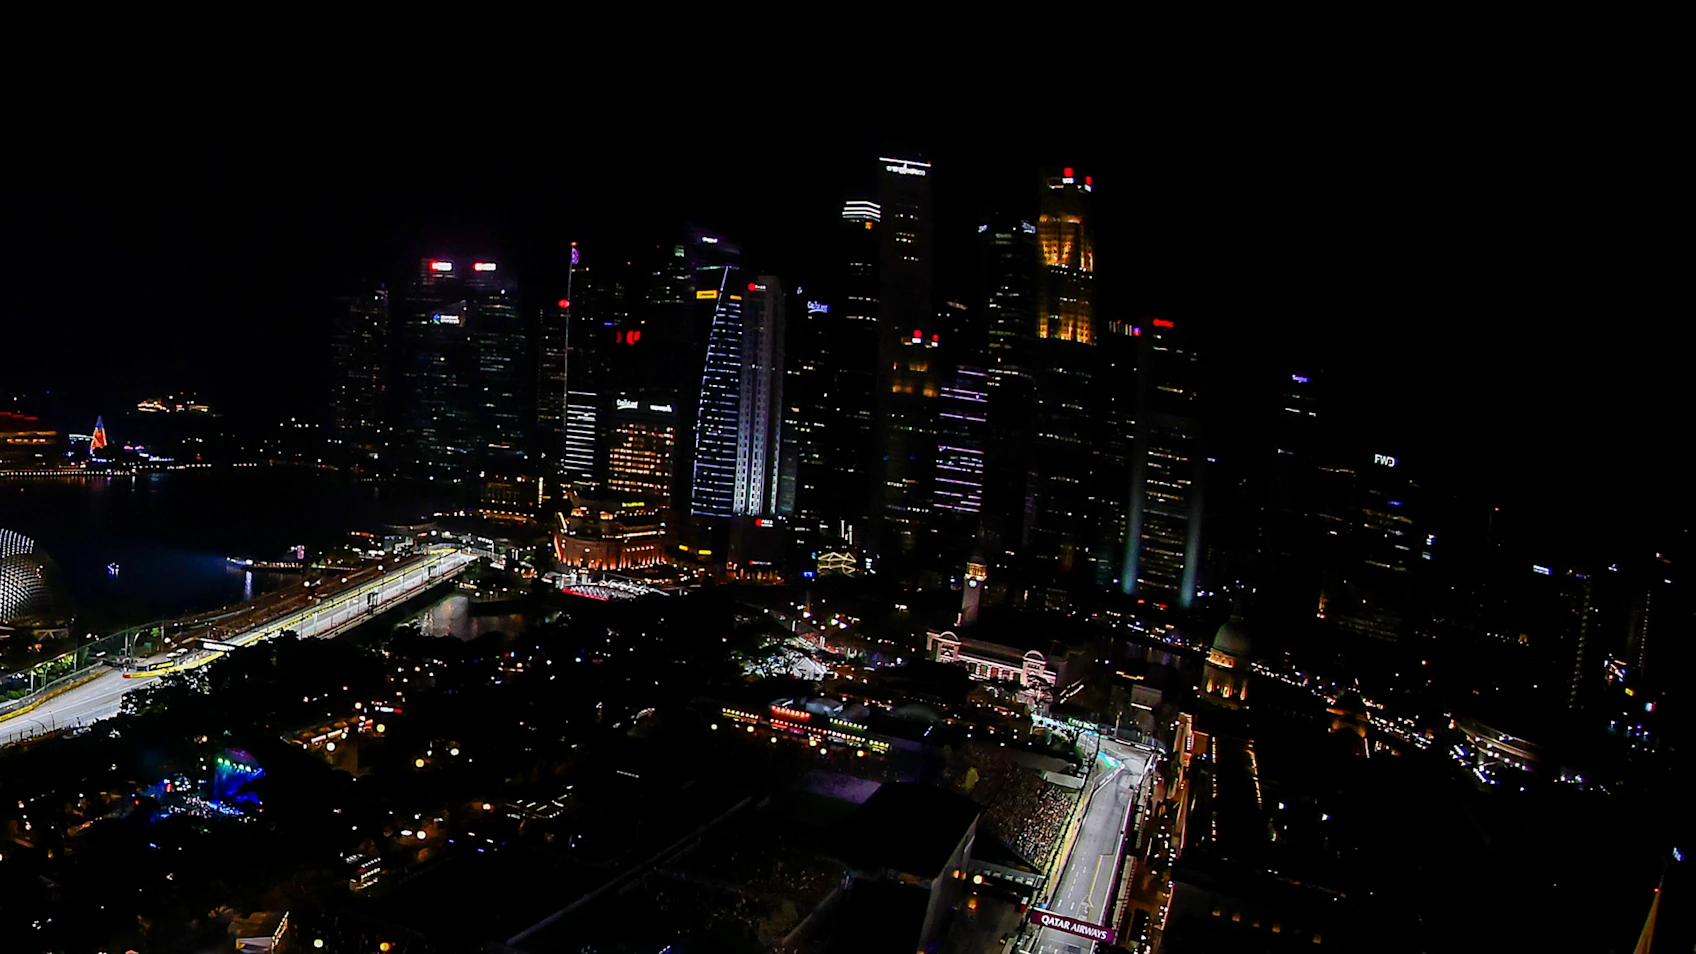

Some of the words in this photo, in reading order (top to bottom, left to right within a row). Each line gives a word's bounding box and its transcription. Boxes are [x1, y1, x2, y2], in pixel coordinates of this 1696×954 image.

[1374, 453, 1395, 467] FWD
[1041, 915, 1070, 929] QATAR
[1070, 924, 1107, 939] AIRWAYS
